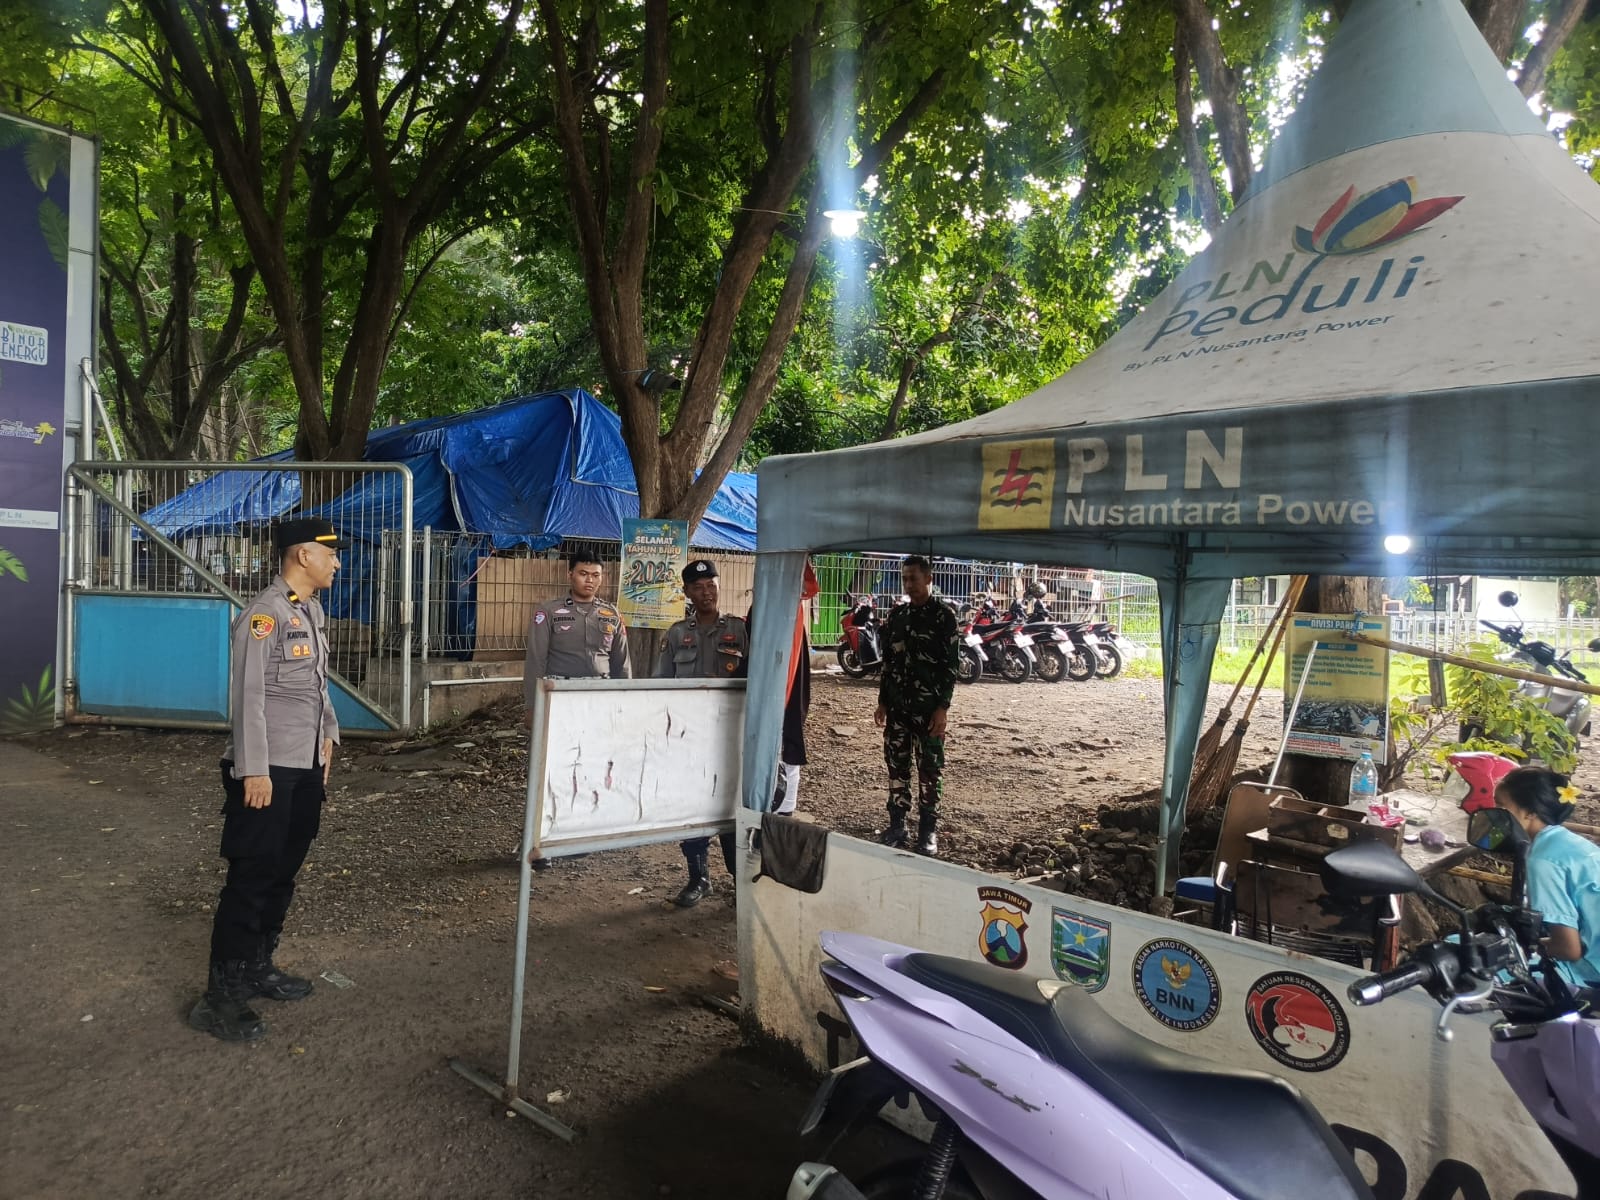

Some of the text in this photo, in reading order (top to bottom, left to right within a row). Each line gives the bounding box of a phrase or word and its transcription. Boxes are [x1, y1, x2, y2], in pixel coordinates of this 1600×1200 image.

[1142, 253, 1425, 352] peduli
[1169, 252, 1295, 315] PLN
[1122, 314, 1396, 372] By PLN Nusantara Power
[1066, 427, 1244, 494] PLN
[1063, 498, 1241, 527] Nusantara
[627, 544, 682, 555] TAHUN BARU
[635, 536, 674, 545] SELAMAT
[630, 560, 675, 585] 2025
[1311, 619, 1364, 631] DIVISI PARKR
[981, 890, 1028, 909] JAWA TIMUR
[1136, 941, 1217, 992] BADAN NARKOTIKA NASIONAL
[1136, 981, 1217, 1029] REPUBLIK INDONESIA
[1156, 988, 1195, 1013] BNN
[1256, 976, 1344, 1032] SATUAN RESERSE NARKOBA
